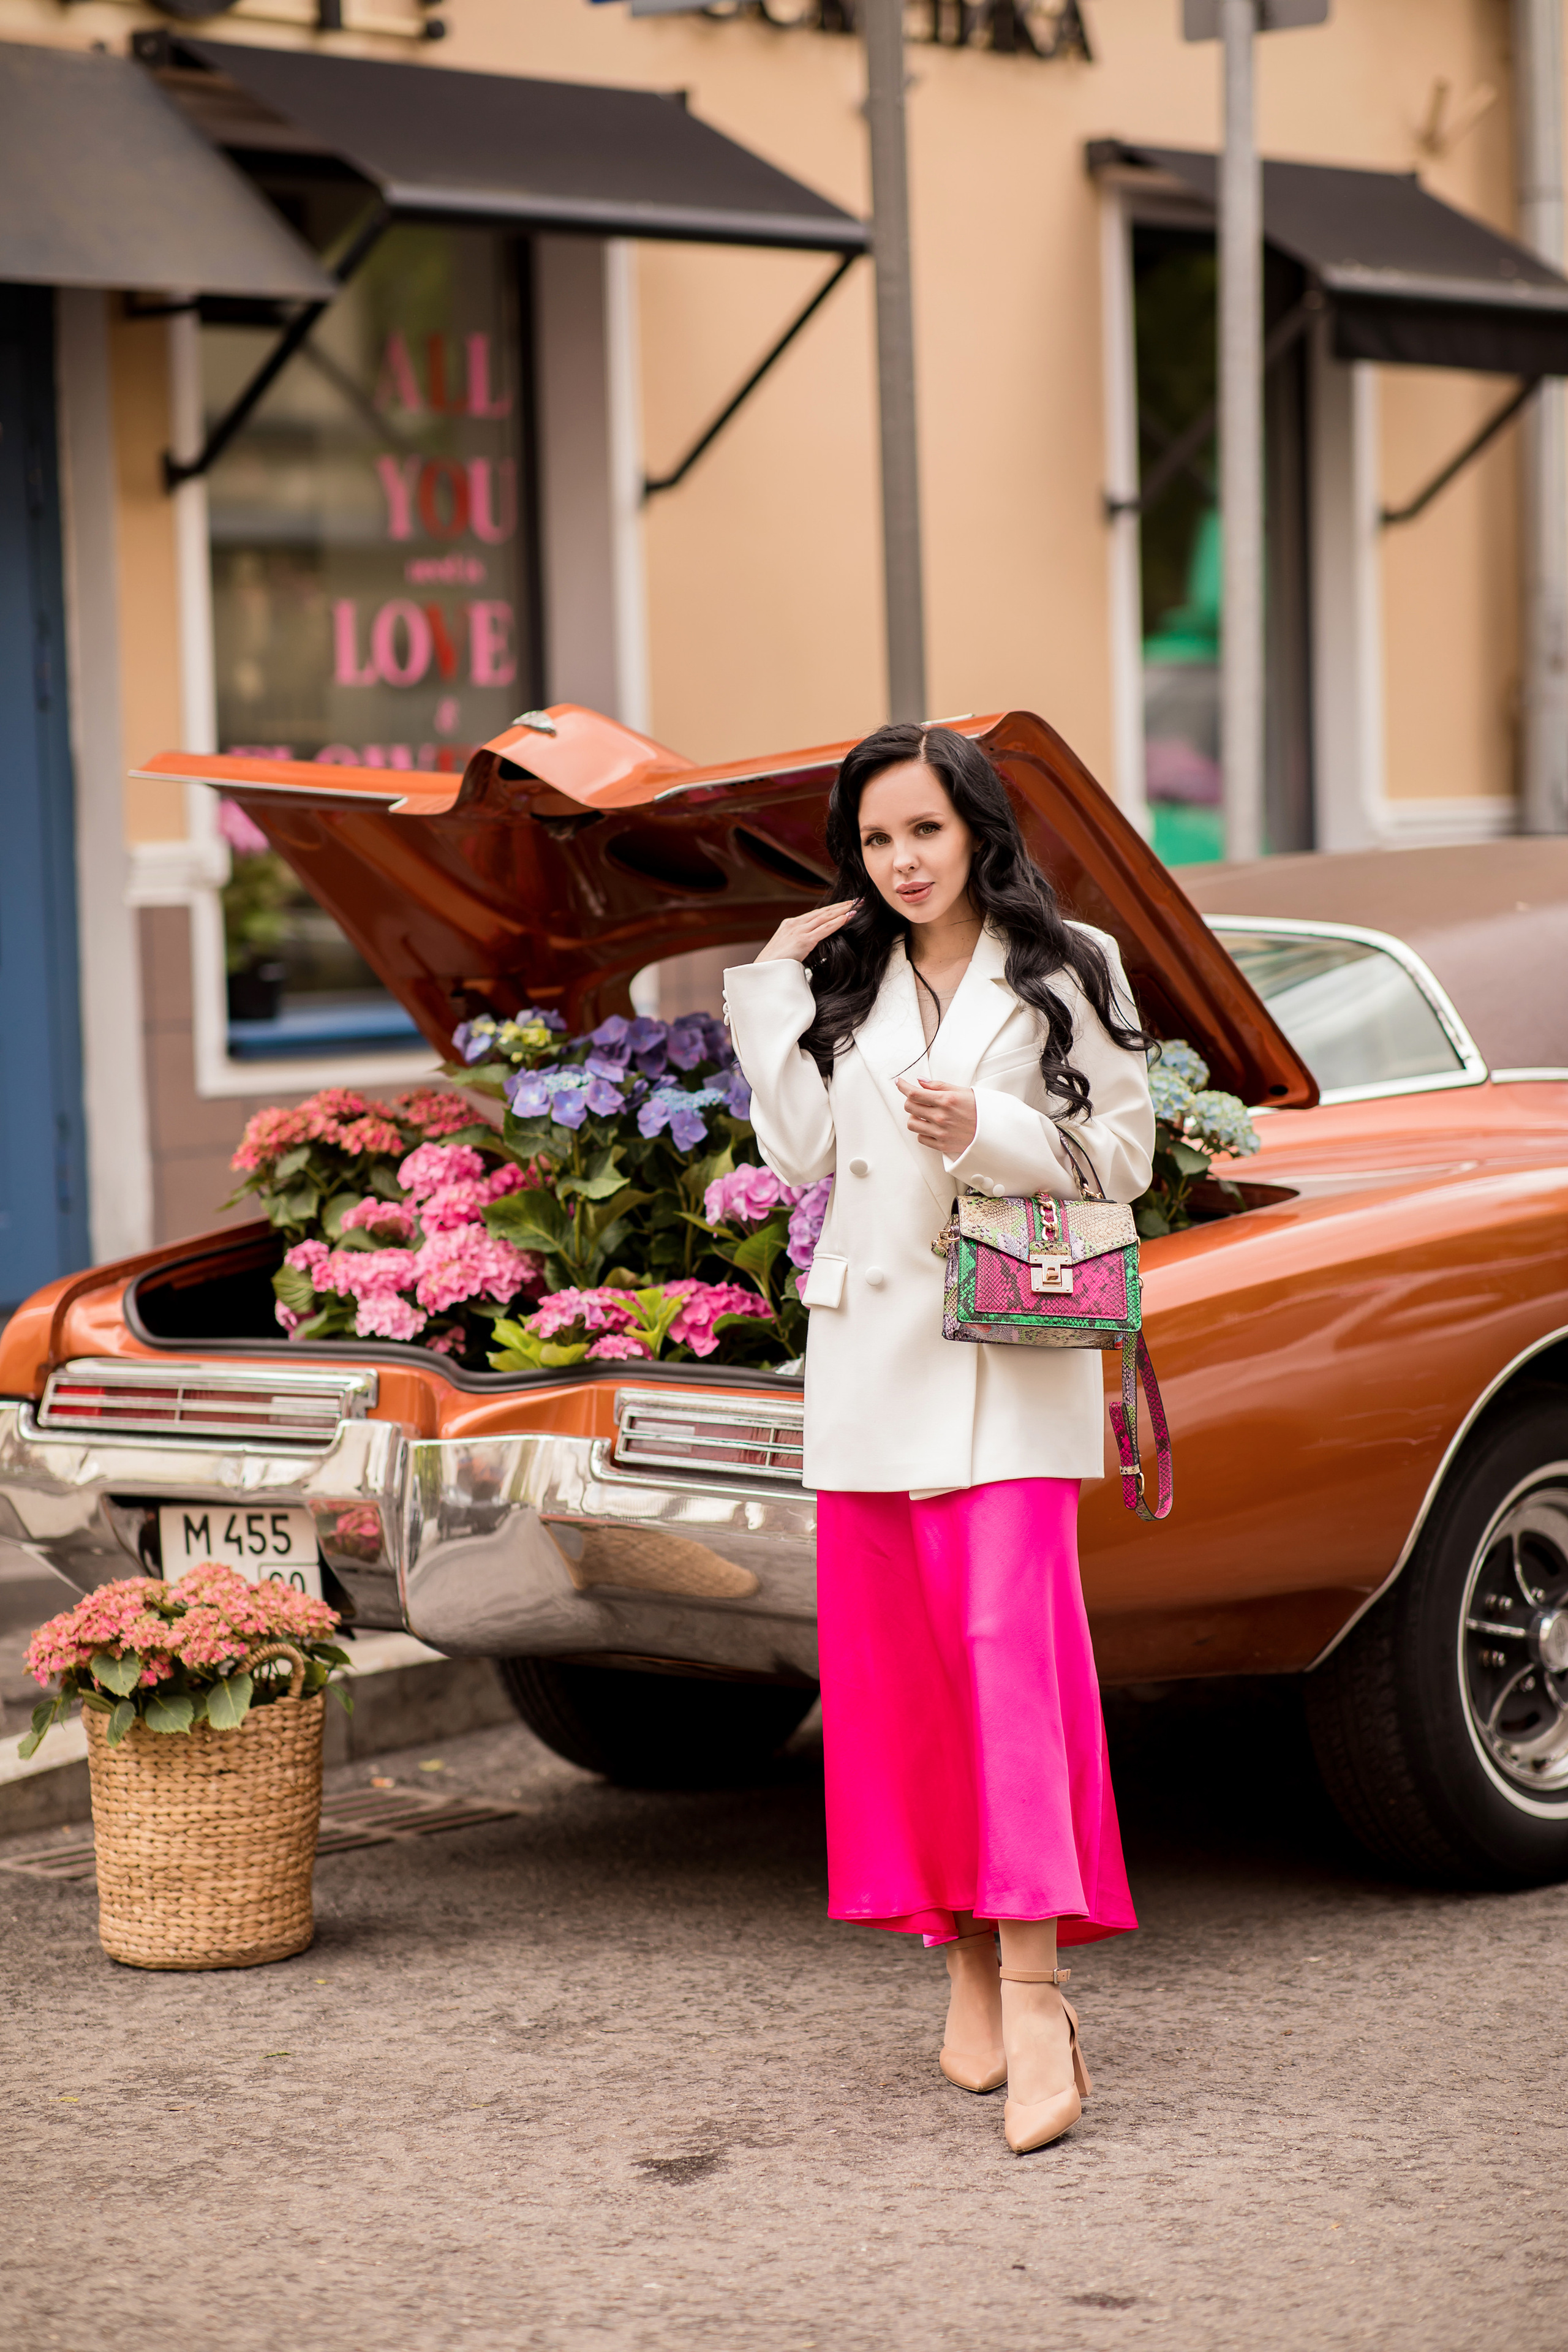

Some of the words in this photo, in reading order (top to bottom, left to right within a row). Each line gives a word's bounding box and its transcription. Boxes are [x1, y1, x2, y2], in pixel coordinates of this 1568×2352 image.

[374, 331, 513, 417] ALL
[375, 456, 518, 544] YOU
[334, 600, 516, 687] LOVE
[184, 1514, 211, 1555] M
[224, 1514, 292, 1555] 455
